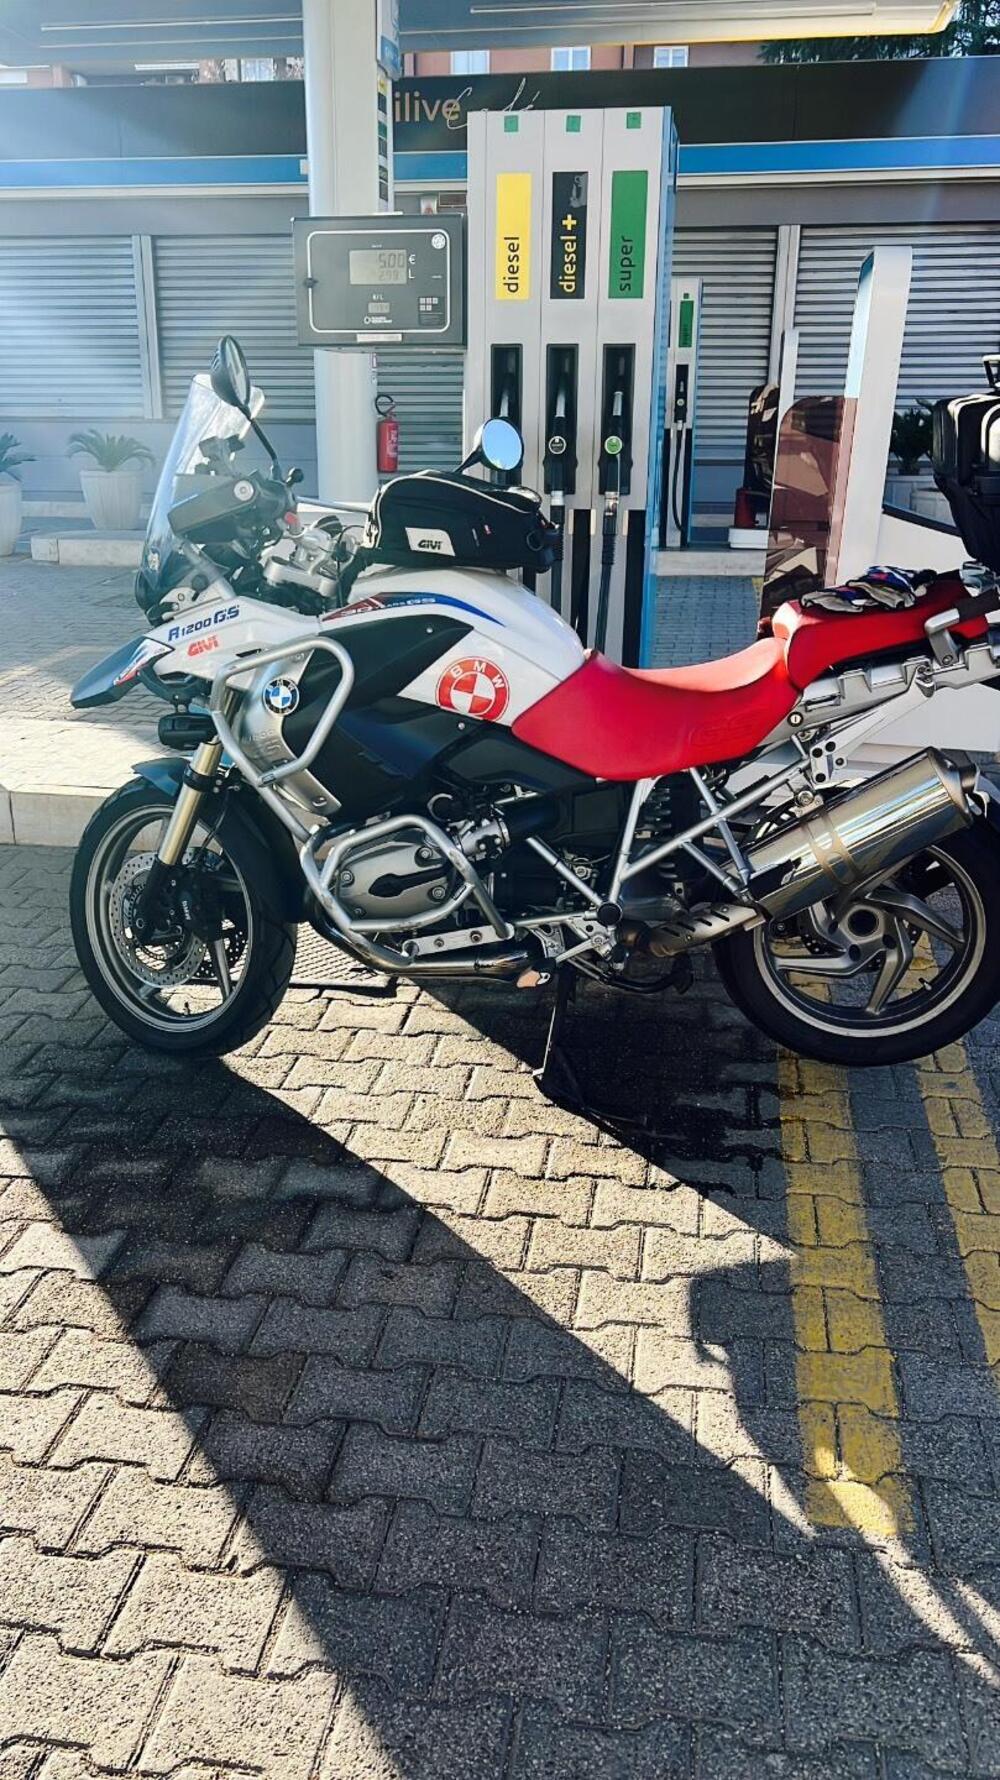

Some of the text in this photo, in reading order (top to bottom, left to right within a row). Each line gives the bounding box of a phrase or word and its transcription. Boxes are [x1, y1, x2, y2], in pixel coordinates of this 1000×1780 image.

[394, 90, 461, 123] ilive
[408, 268, 416, 279] L
[502, 236, 520, 293] diesel
[559, 235, 577, 293] diesel
[618, 235, 636, 293] super
[187, 634, 219, 657] GIVI
[450, 660, 505, 689] BMW
